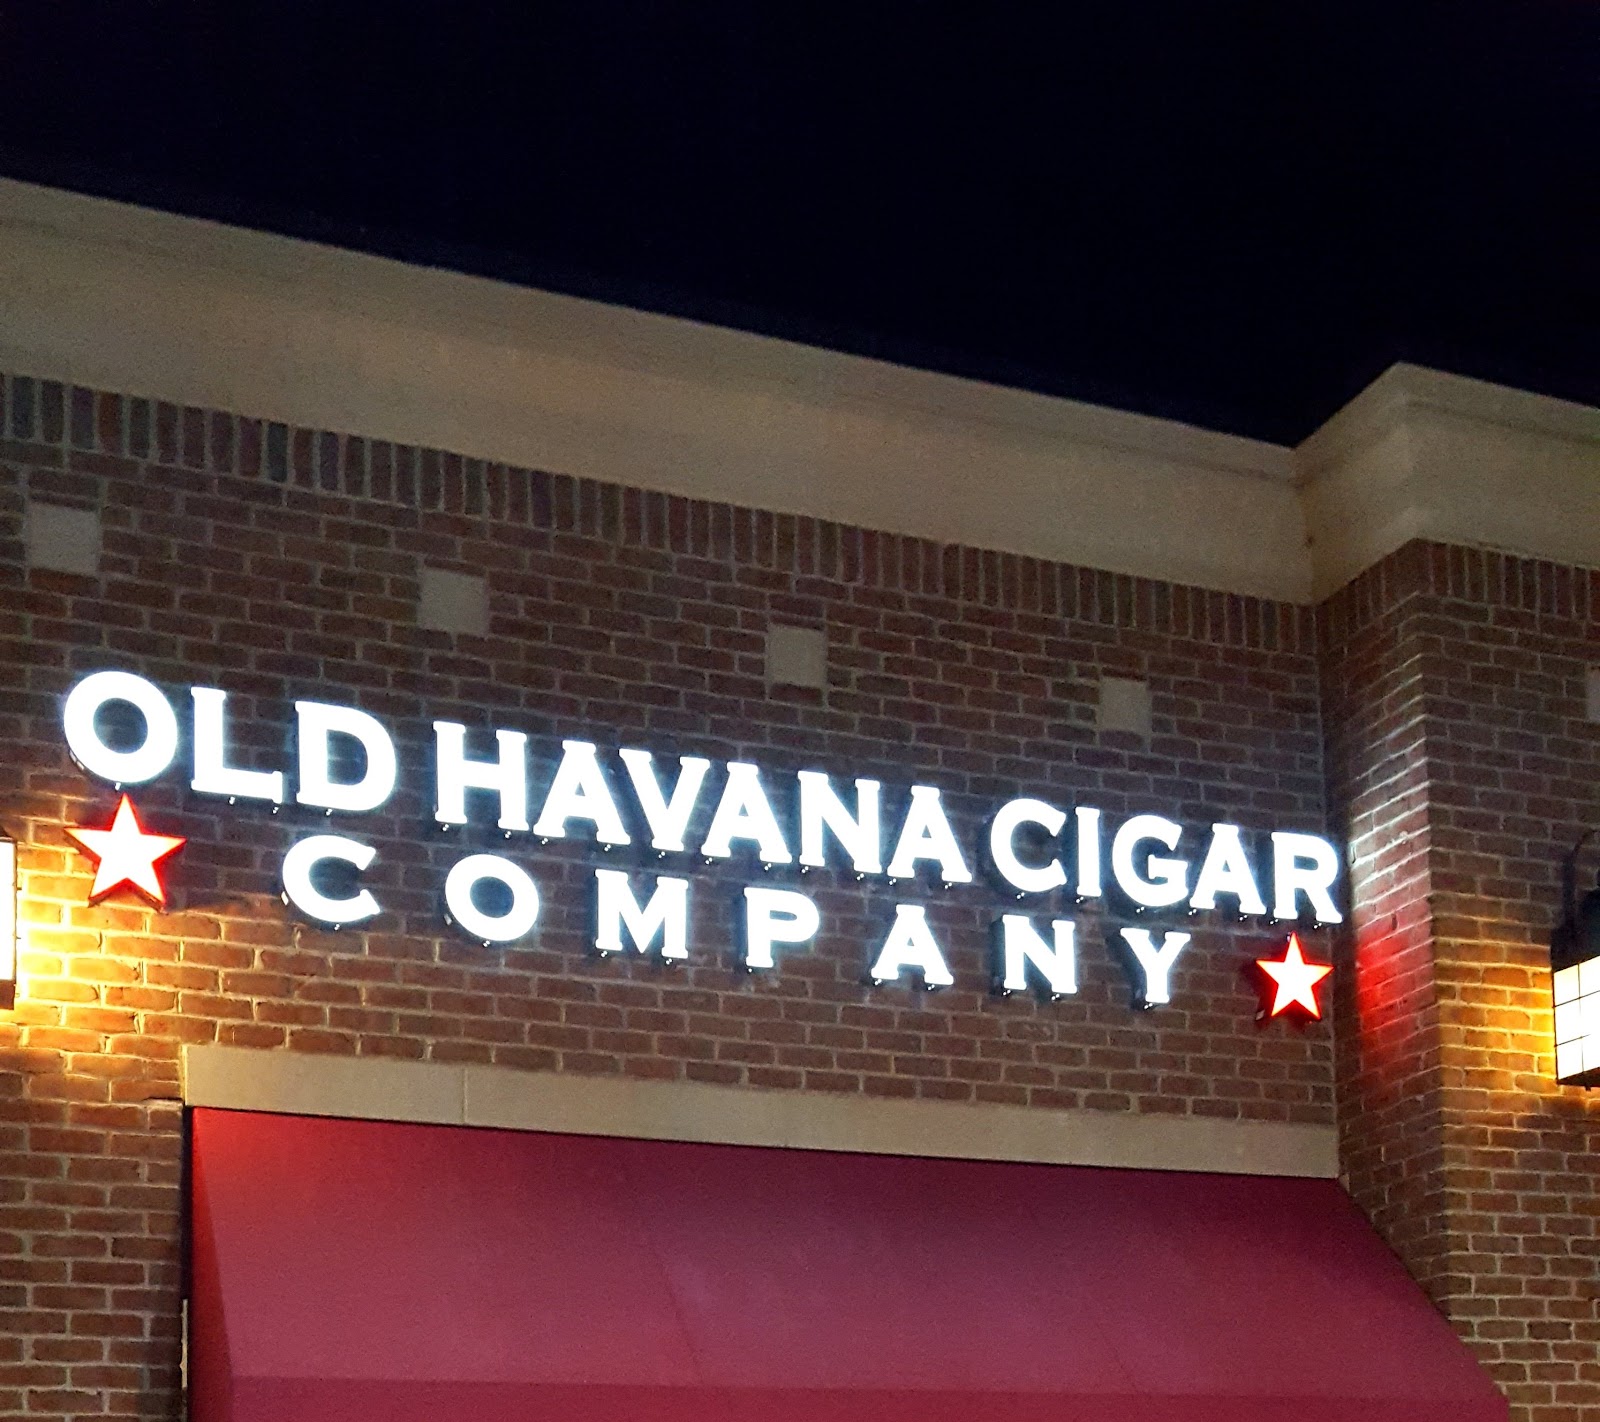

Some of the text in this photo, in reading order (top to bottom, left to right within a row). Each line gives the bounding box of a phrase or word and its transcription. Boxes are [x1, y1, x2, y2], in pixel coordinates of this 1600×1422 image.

[63, 670, 1343, 925] OLD HAVANA CIGAR
[281, 834, 1191, 1005] COMPANY
